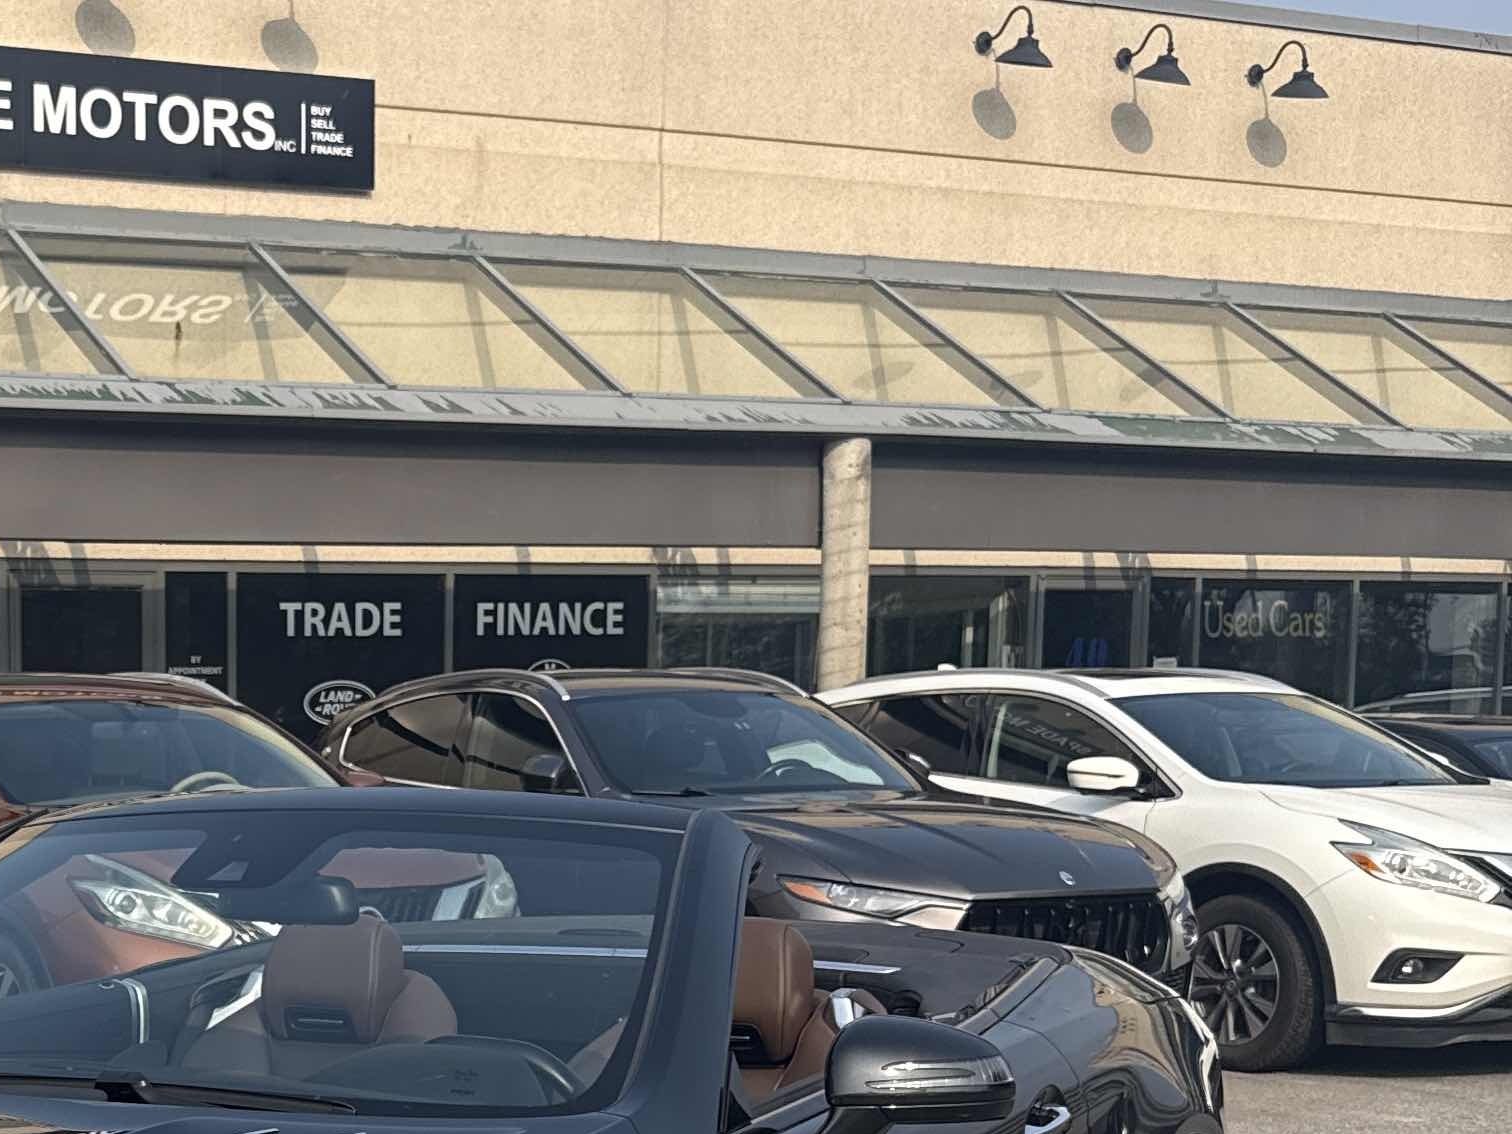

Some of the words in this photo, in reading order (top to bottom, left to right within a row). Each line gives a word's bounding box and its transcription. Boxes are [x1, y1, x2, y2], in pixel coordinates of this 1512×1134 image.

[32, 83, 277, 152] MOTORS
[274, 139, 296, 153] INC
[310, 105, 333, 117] BUY
[310, 118, 337, 131] SELL
[310, 131, 345, 144] TRADE
[310, 144, 355, 158] FINANCE
[279, 601, 403, 637] TRADE
[475, 601, 625, 636] FINANCE
[1203, 600, 1264, 638] Used
[1269, 599, 1326, 638] Cars
[319, 690, 354, 703] LAND
